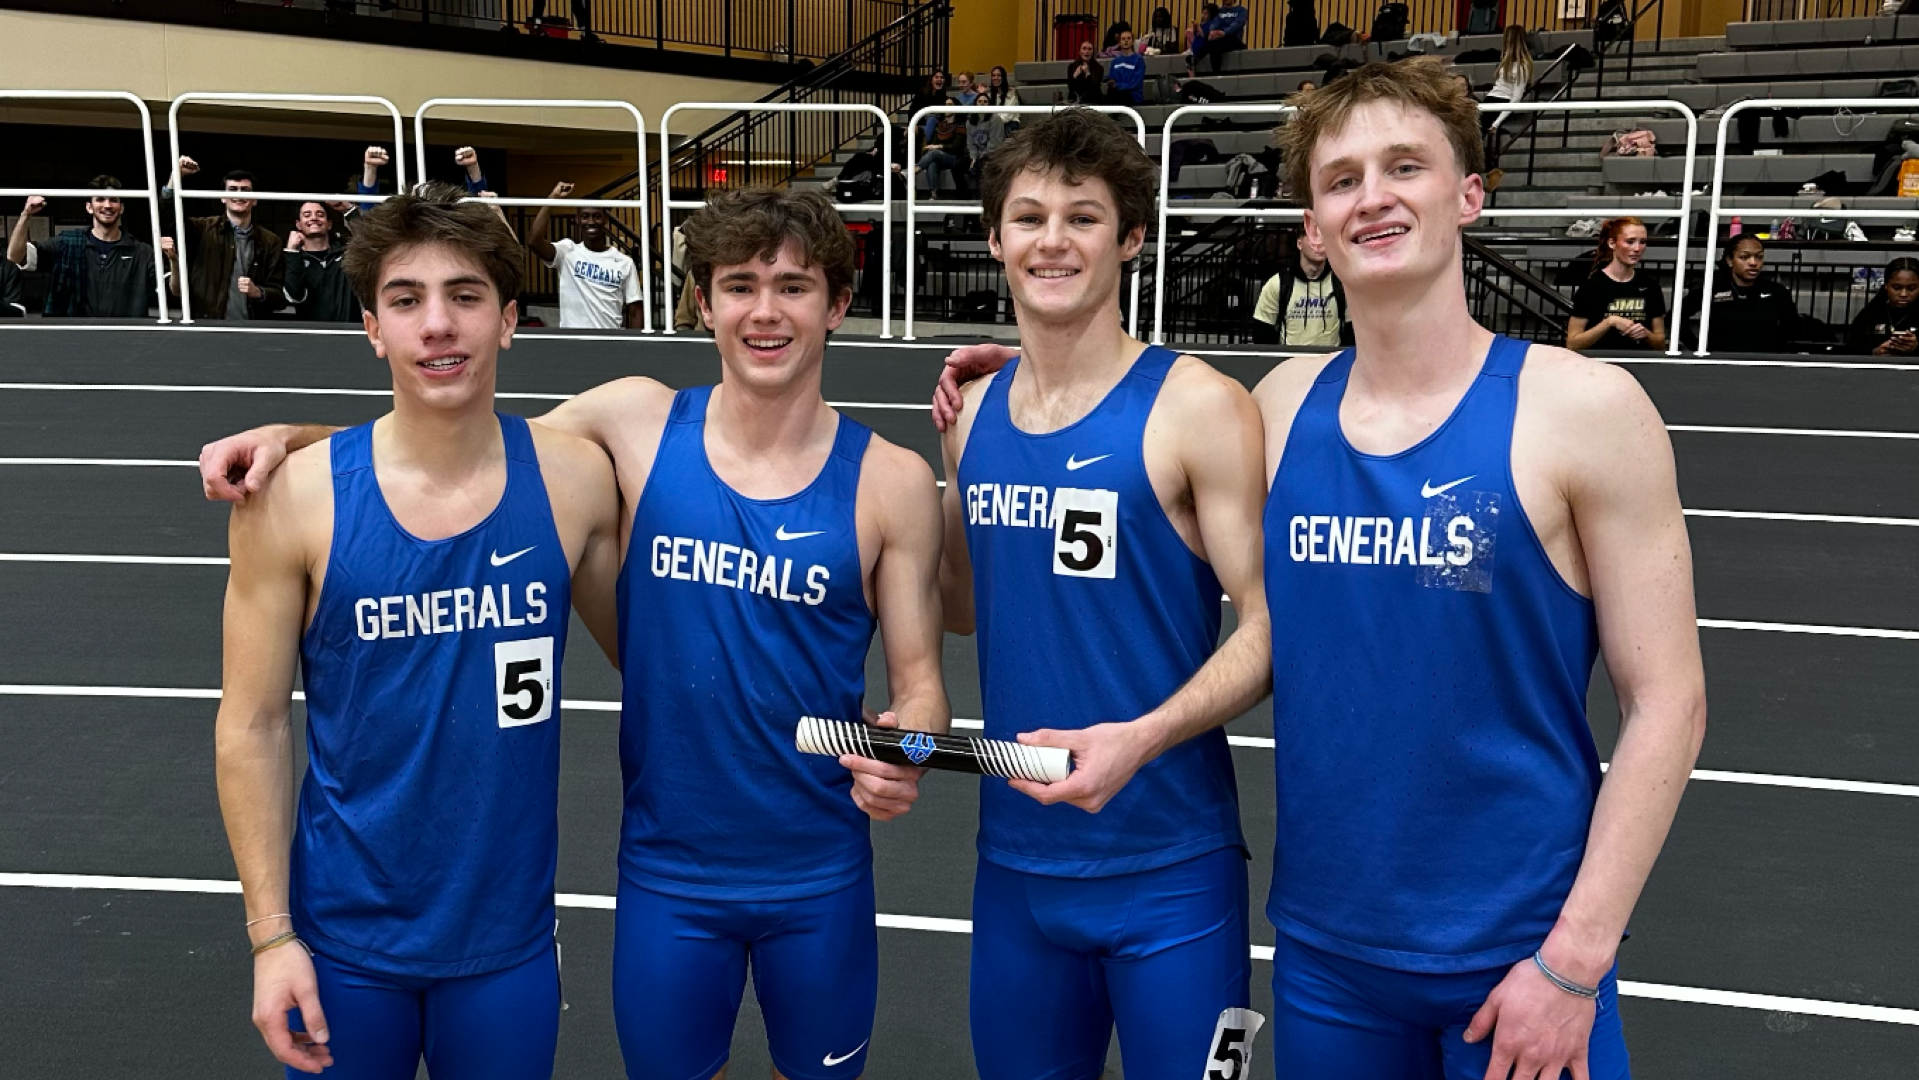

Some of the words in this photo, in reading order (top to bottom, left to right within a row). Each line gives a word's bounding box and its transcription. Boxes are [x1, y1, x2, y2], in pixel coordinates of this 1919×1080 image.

[574, 260, 622, 284] GENERALS
[1295, 298, 1329, 308] JMU
[1607, 298, 1645, 311] JMU
[1058, 509, 1104, 571] 5
[1289, 515, 1475, 566] GENERALS
[651, 535, 830, 606] GENERALS
[354, 581, 548, 641] GENERALS
[501, 658, 544, 720] 5
[1208, 1027, 1246, 1080] 5
